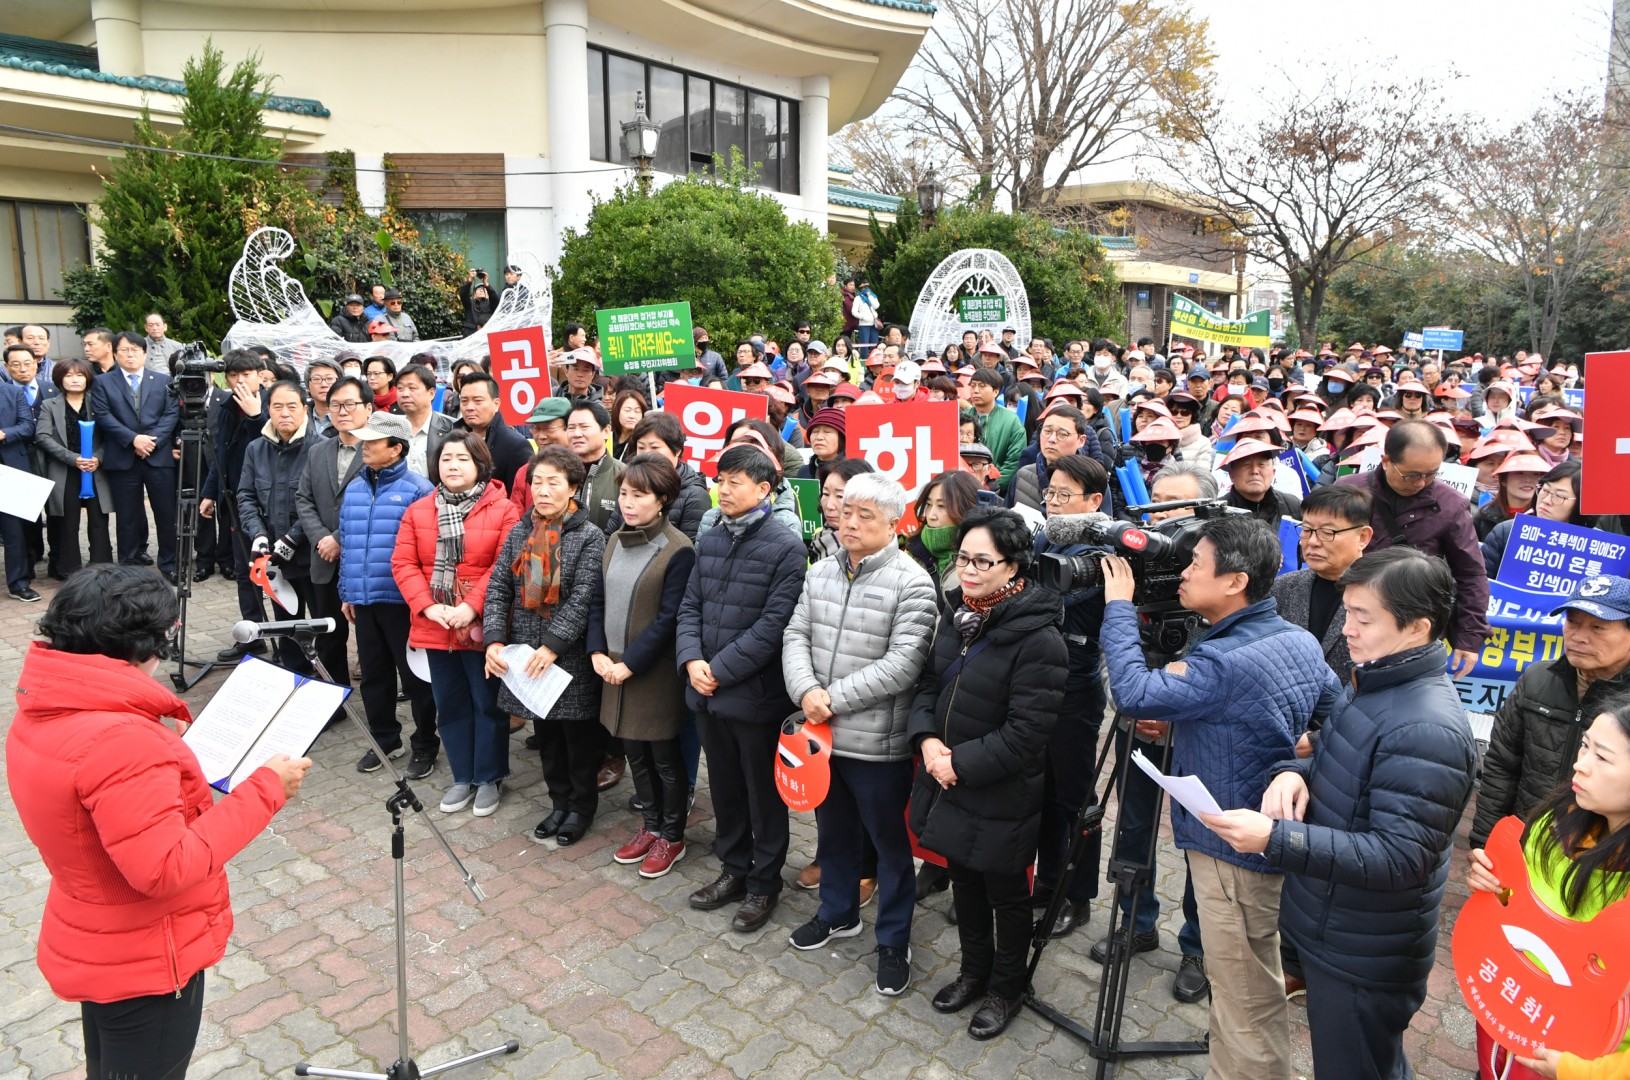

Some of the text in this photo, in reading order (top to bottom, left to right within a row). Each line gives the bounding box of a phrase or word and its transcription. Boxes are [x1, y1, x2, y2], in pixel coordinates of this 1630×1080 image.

[608, 331, 685, 359] 꼭!! 지켜주세요~~
[501, 340, 540, 414] 공
[859, 421, 944, 518] 화
[1125, 534, 1143, 545] KNN
[1520, 524, 1546, 542] 엄마~
[1547, 530, 1588, 552] 초록색이
[1515, 545, 1603, 577] 세상이 온통
[1526, 570, 1577, 595] 회색이
[1470, 986, 1485, 1010] 해운대
